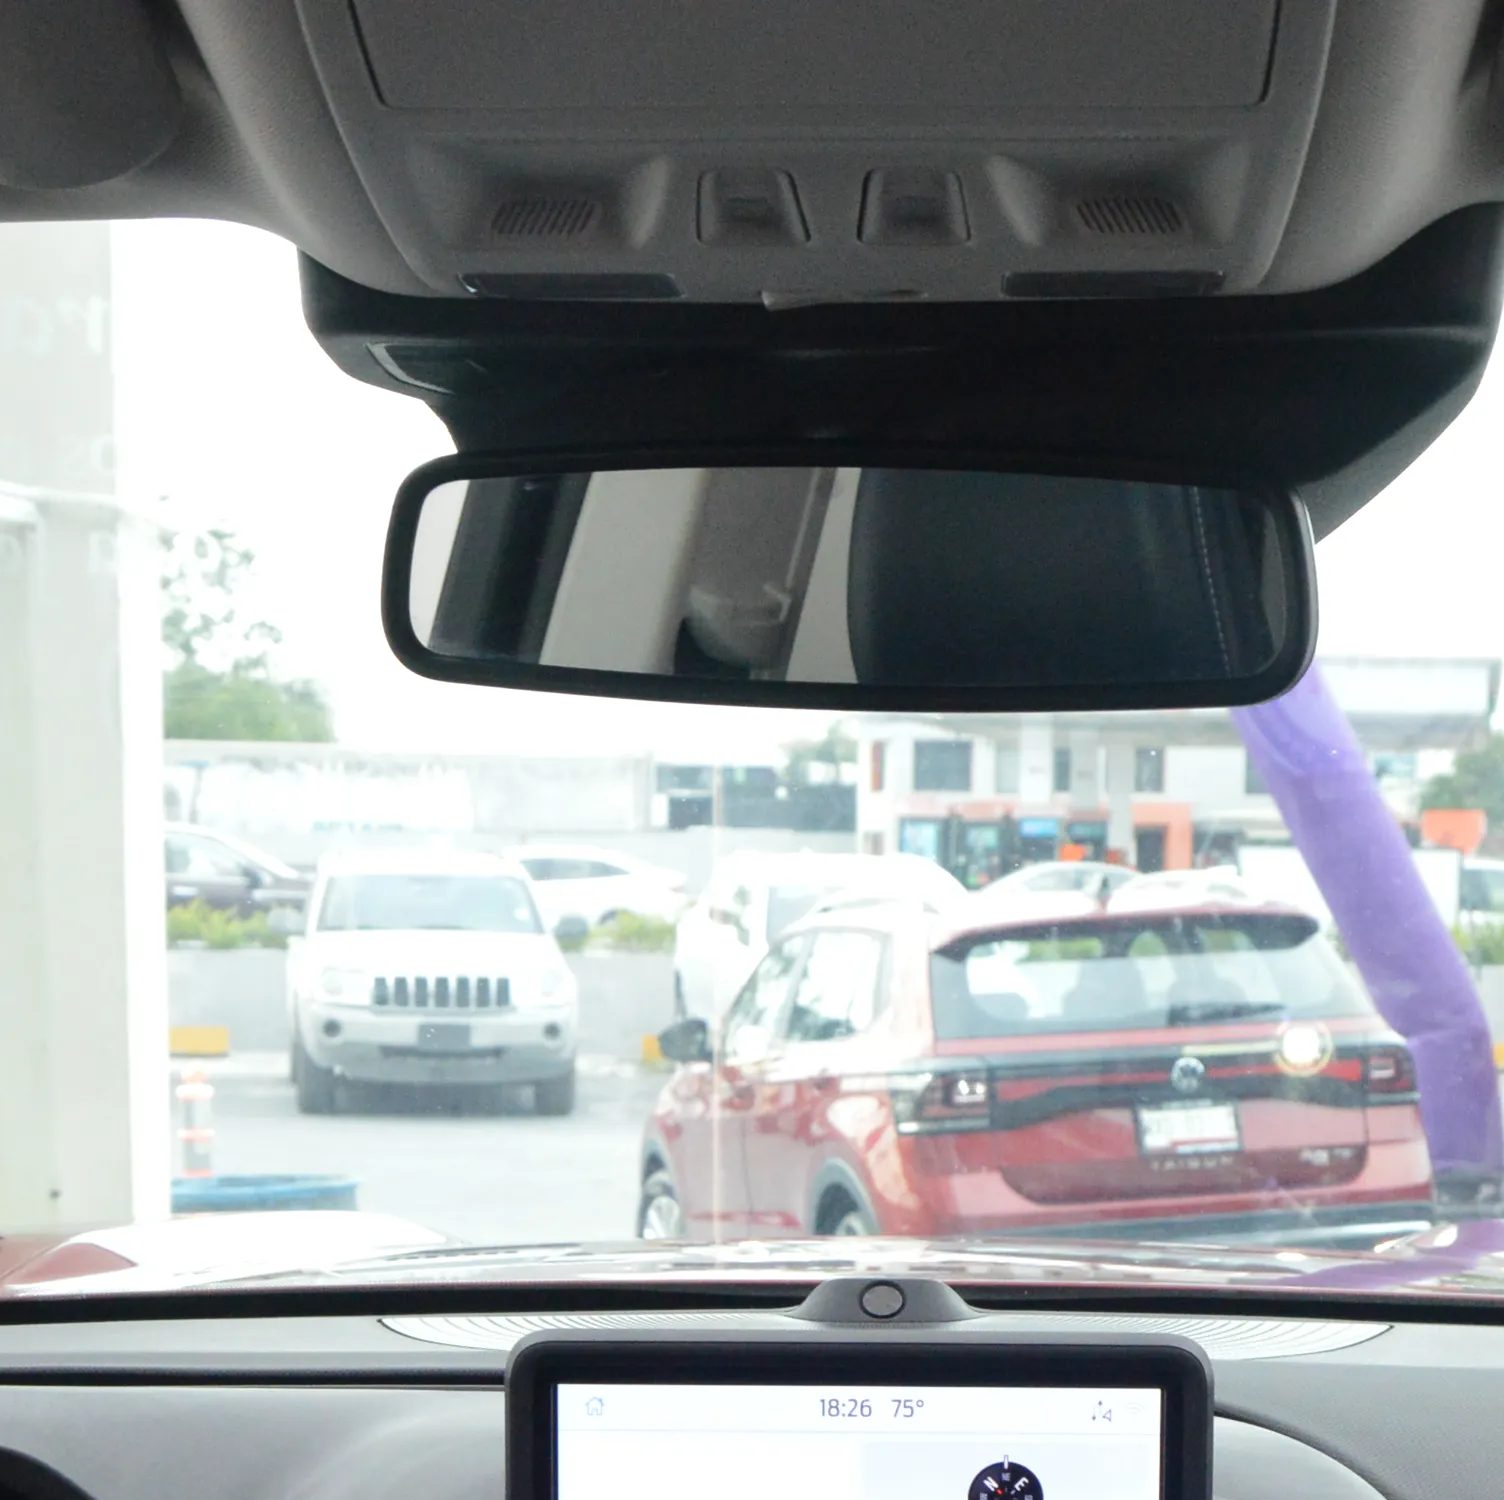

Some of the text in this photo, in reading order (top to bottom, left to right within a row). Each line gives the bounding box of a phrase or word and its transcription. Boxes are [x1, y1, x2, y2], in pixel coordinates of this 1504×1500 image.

[819, 1398, 925, 1418] 18:26 75°
[983, 1476, 999, 1492] N
[1014, 1476, 1029, 1492] E
